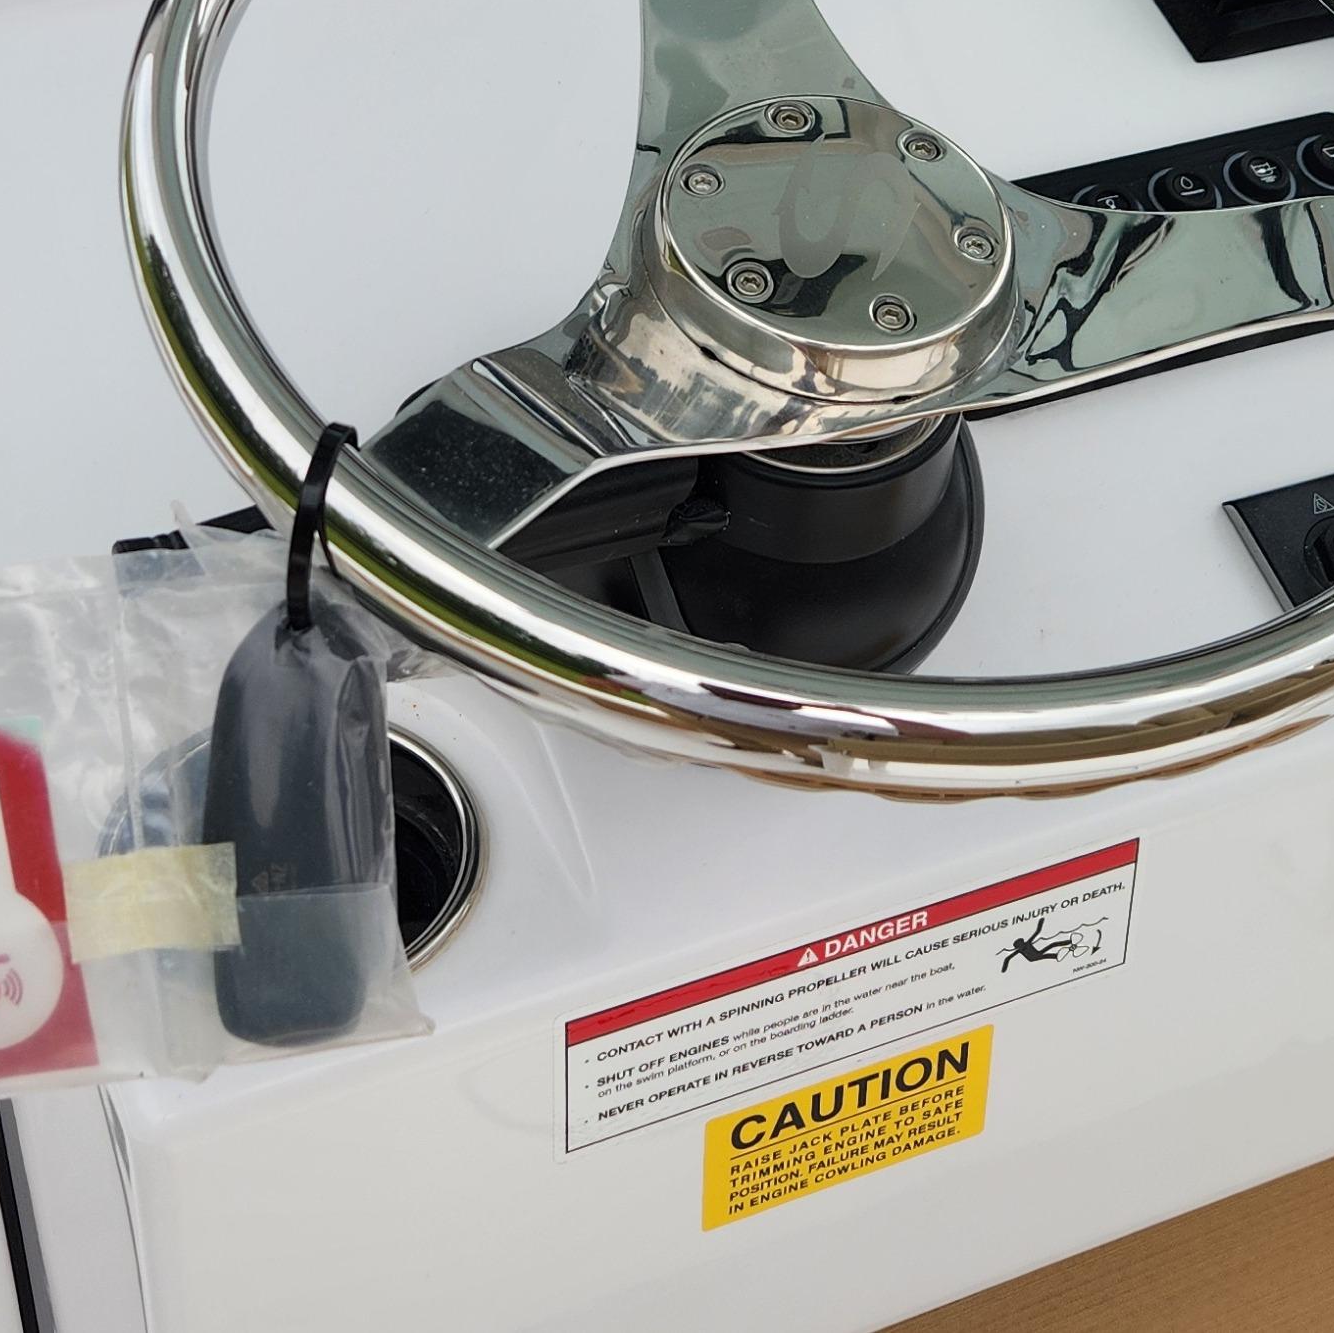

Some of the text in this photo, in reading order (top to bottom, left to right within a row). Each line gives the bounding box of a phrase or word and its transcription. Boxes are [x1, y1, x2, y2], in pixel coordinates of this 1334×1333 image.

[597, 881, 1125, 1061] CONTACT WITH A SPINNING PROPELLER WILL CAUSE SERIOUS INJURY OR DEATH.
[824, 910, 928, 958] DANGER
[597, 1066, 635, 1087] SHUT
[638, 1056, 665, 1072] OFF
[669, 1035, 729, 1063] ENGINES
[732, 1027, 760, 1042] while
[763, 1014, 800, 1033] people
[802, 1008, 819, 1019] are
[821, 1004, 831, 1012] in
[833, 997, 851, 1008] the
[853, 986, 882, 1001] water
[884, 978, 907, 991] near
[910, 972, 927, 982] the
[597, 1007, 852, 1098] on the swim platform, or on the boarding ladder.
[598, 985, 985, 1121] NEVER OPERATE IN REVERSE TOWARD A PERSON in the water.
[730, 1041, 969, 1150] CAUTION
[730, 1084, 964, 1176] RAISE JACK PLATE BEFORE
[728, 1126, 960, 1215] IN ENGINE COWLING DAMAGE.
[729, 1097, 963, 1188] TRIMMING ENGINE TO SAFE
[729, 1111, 962, 1202] POSITION. FAILURE MAY RESULT
